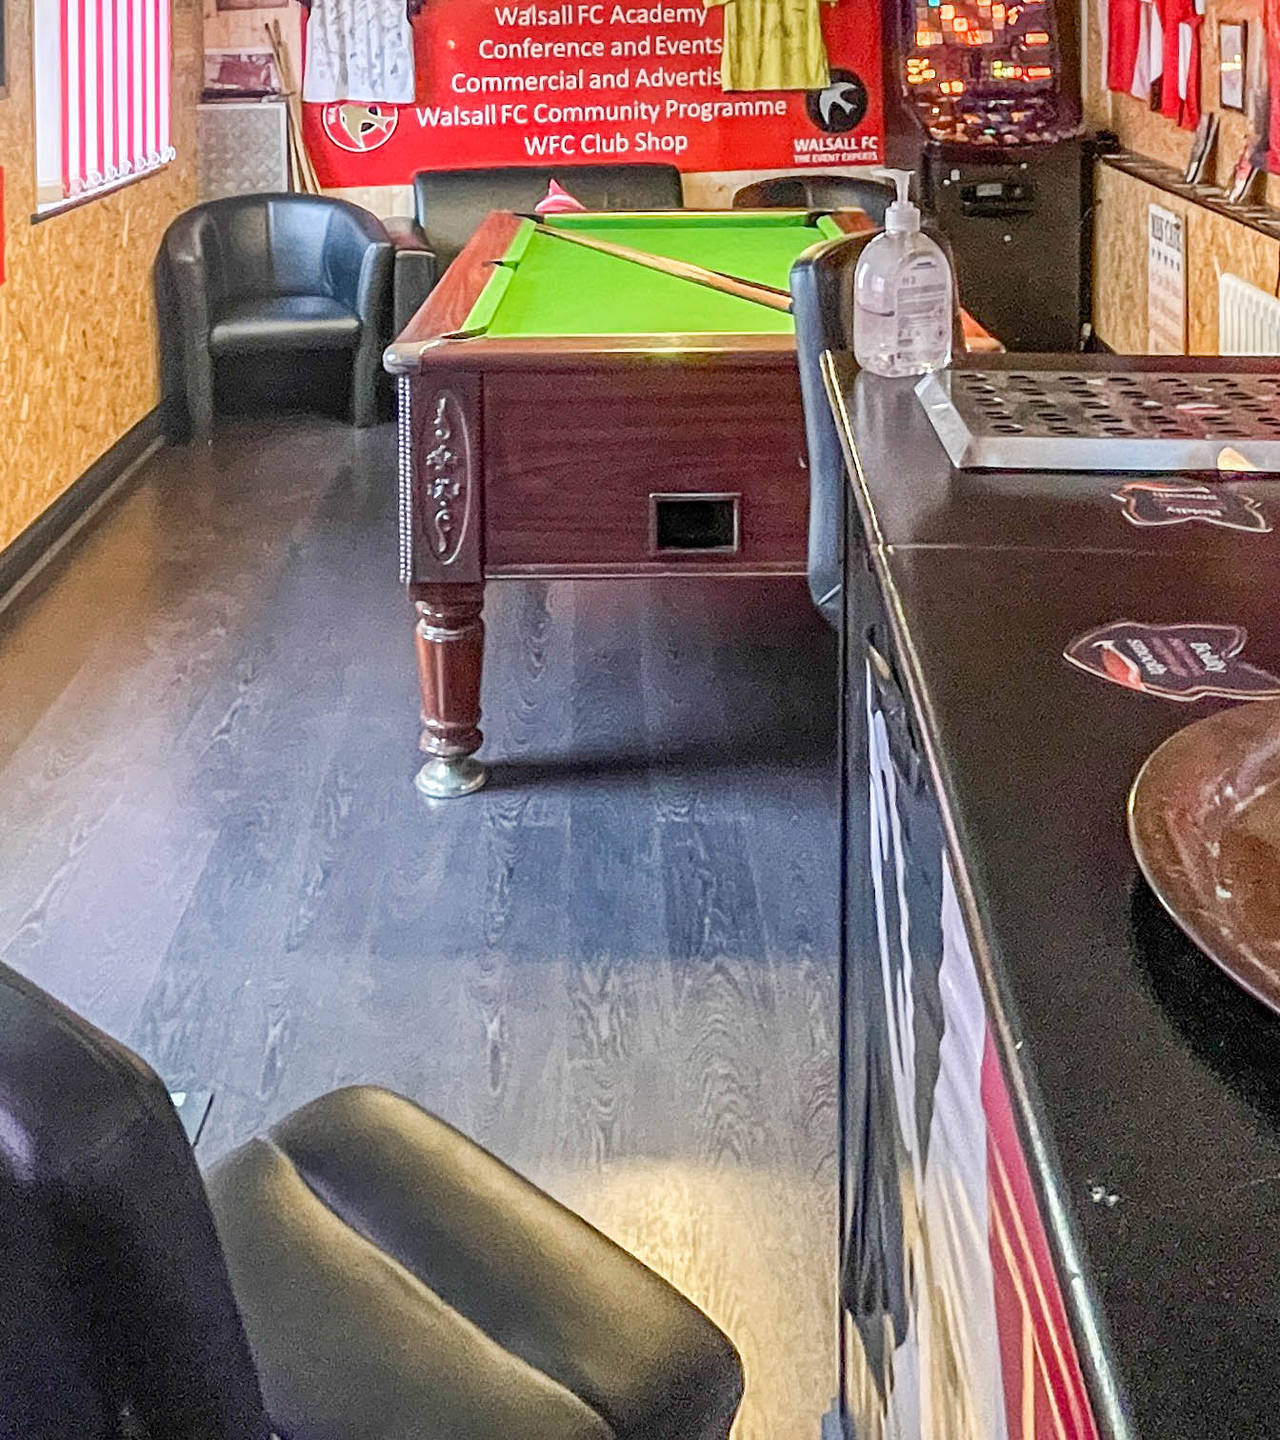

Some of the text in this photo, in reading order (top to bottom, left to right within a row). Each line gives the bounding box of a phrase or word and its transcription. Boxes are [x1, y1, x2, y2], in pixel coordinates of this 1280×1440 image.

[494, 3, 708, 27] Walsall FC Academy
[478, 36, 723, 60] Conference and Events
[451, 70, 722, 94] Commercial and Advertis
[416, 98, 787, 127] Walsall FC Community Programme
[524, 131, 688, 156] WFC Club Shop
[793, 136, 879, 153] WALSALL FC
